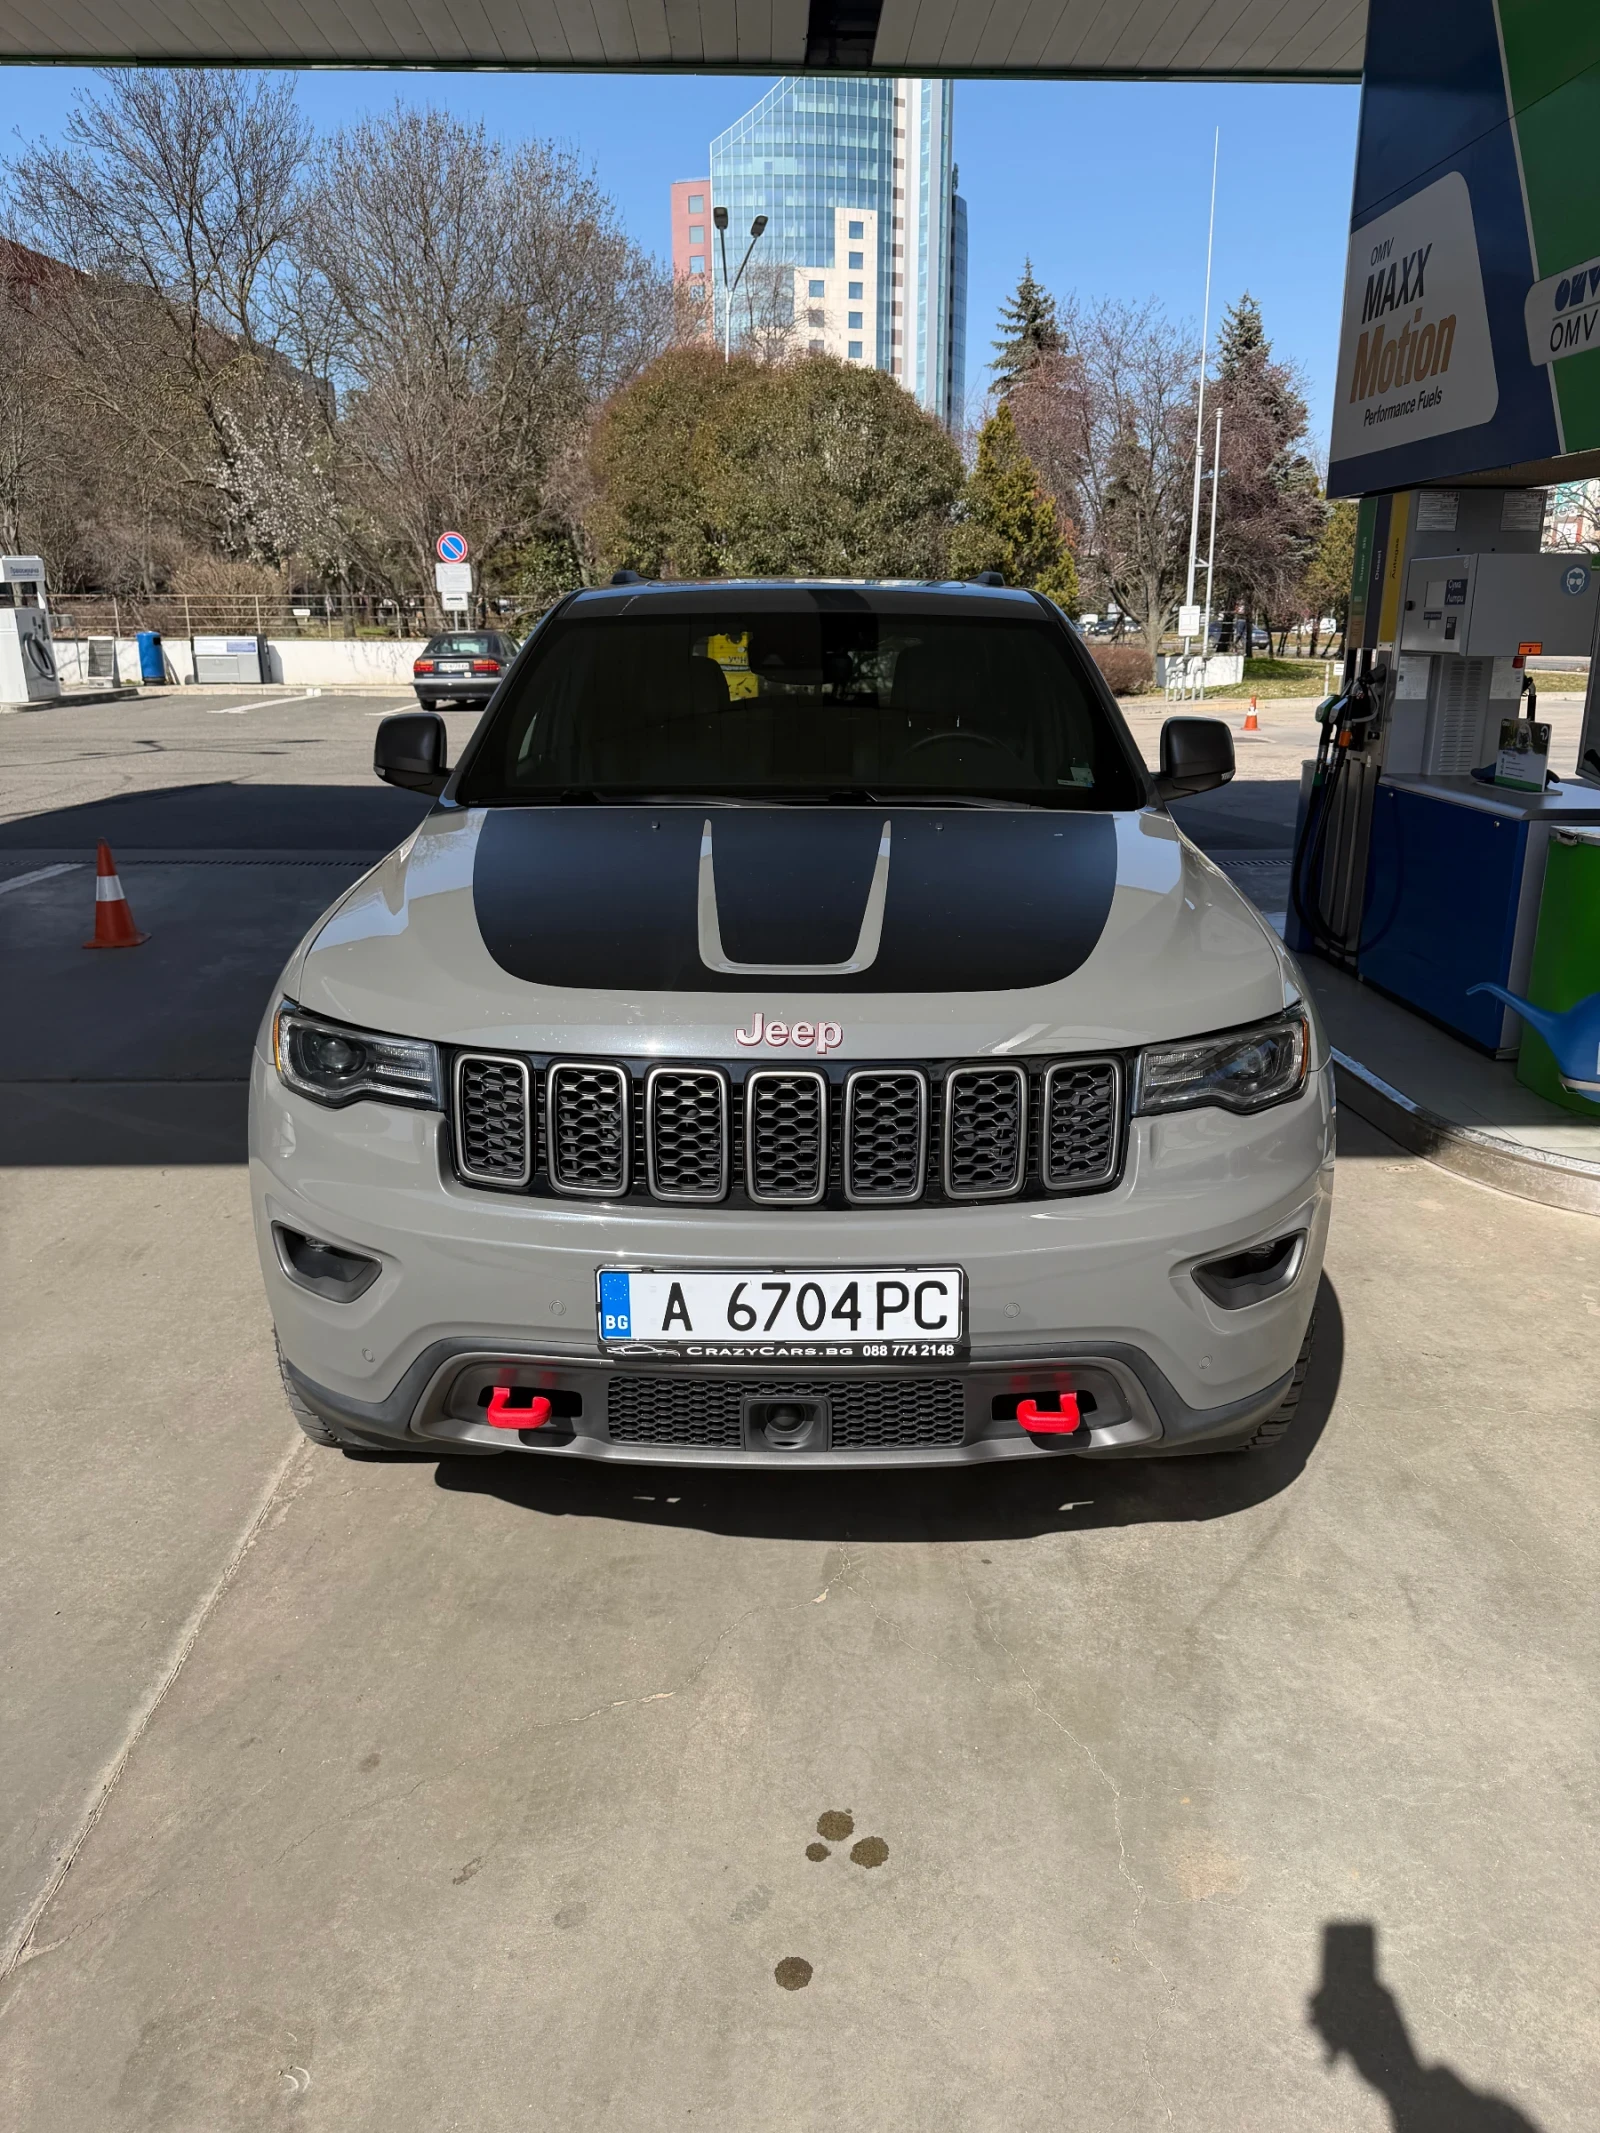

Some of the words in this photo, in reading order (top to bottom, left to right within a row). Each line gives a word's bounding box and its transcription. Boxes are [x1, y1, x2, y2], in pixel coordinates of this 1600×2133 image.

[1370, 237, 1395, 267] OMV
[1361, 242, 1433, 325] MAXX
[1549, 309, 1599, 352] OMV
[1349, 307, 1457, 404] Motion
[1363, 397, 1416, 427] Performance
[1417, 386, 1443, 413] Fuels
[1391, 537, 1400, 580] Autogas
[735, 1012, 843, 1054] Jeep
[604, 1314, 629, 1330] BG
[661, 1281, 693, 1332] A
[726, 1280, 862, 1332] 6704
[875, 1280, 948, 1331] PC
[862, 1344, 887, 1357] 088
[892, 1344, 917, 1357] 774
[920, 1344, 955, 1357] 2148
